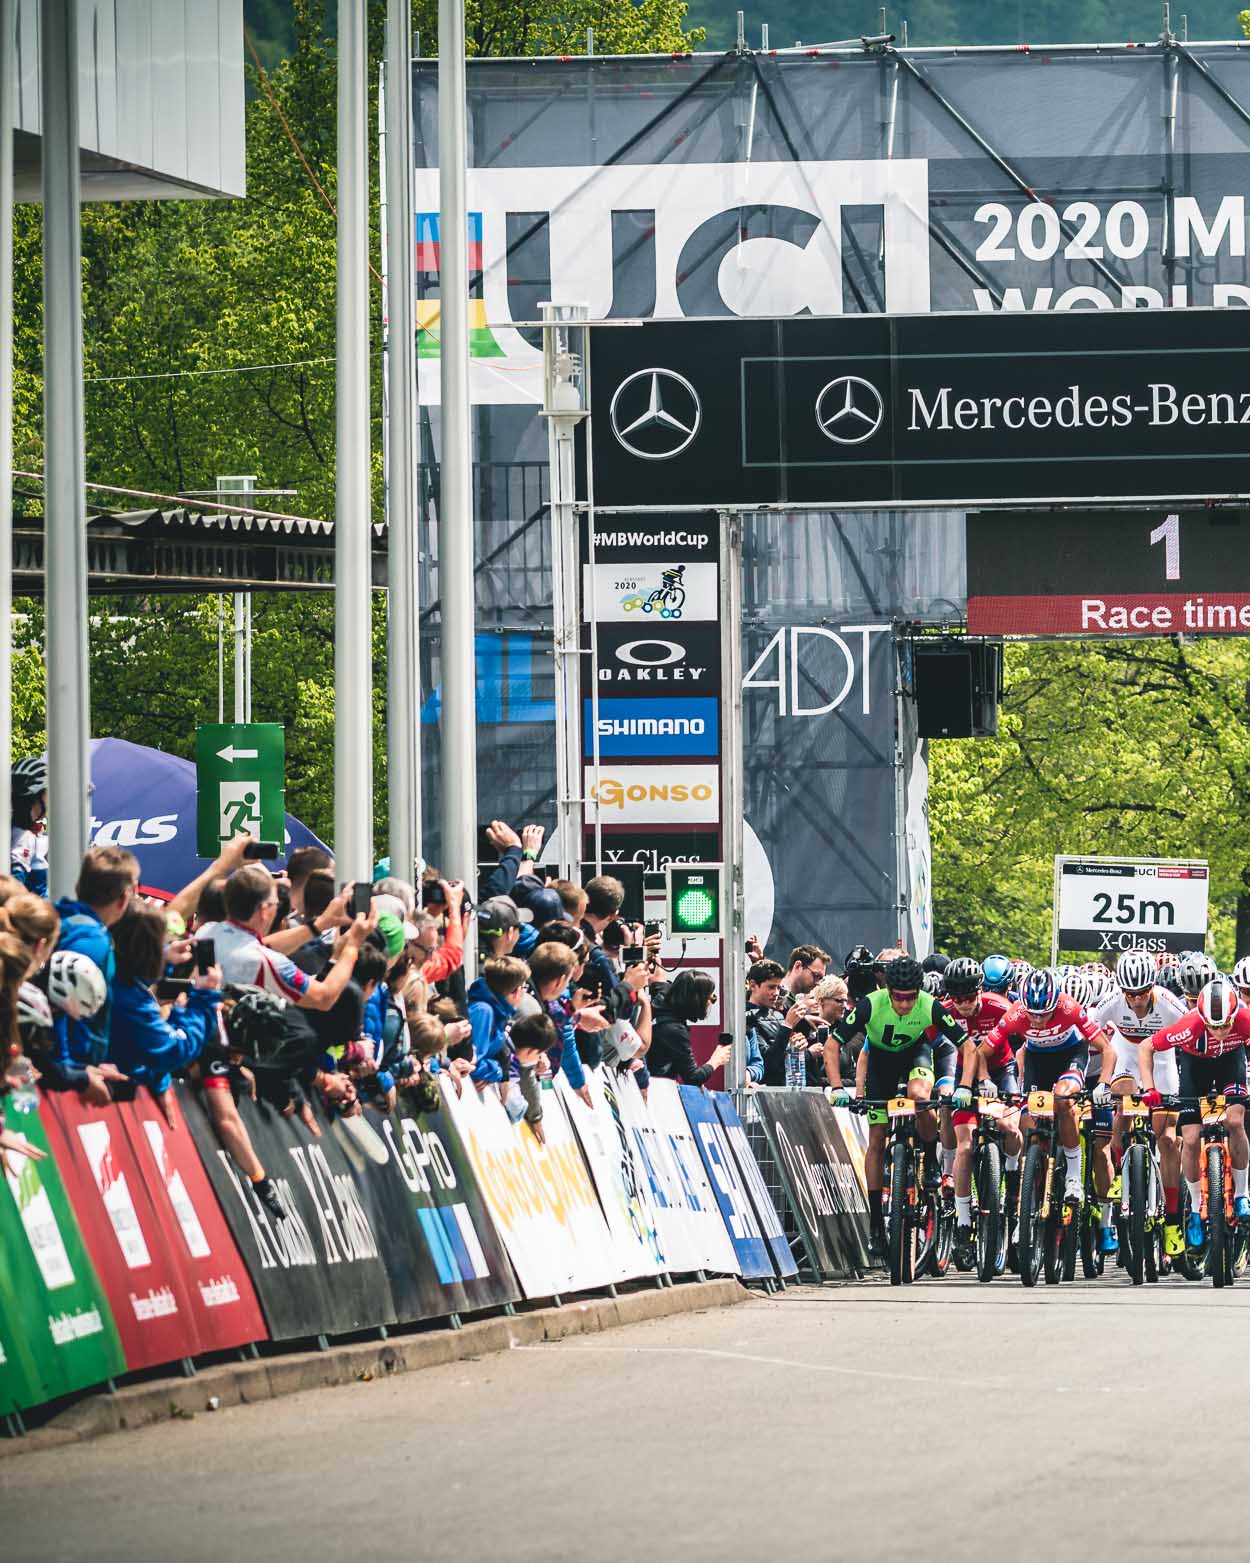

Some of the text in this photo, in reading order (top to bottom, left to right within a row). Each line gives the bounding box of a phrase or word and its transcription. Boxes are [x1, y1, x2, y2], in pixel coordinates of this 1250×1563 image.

[973, 199, 1150, 262] 2020
[592, 531, 709, 549] #MBWorldCup
[1149, 514, 1180, 580] 1
[614, 582, 637, 590] 2020
[1081, 598, 1186, 630] Race
[599, 667, 705, 681] OAKLEY
[598, 718, 705, 736] SHIMANO
[1138, 868, 1156, 876] UCI
[1092, 892, 1175, 925] 25m
[1037, 1095, 1045, 1108] 3
